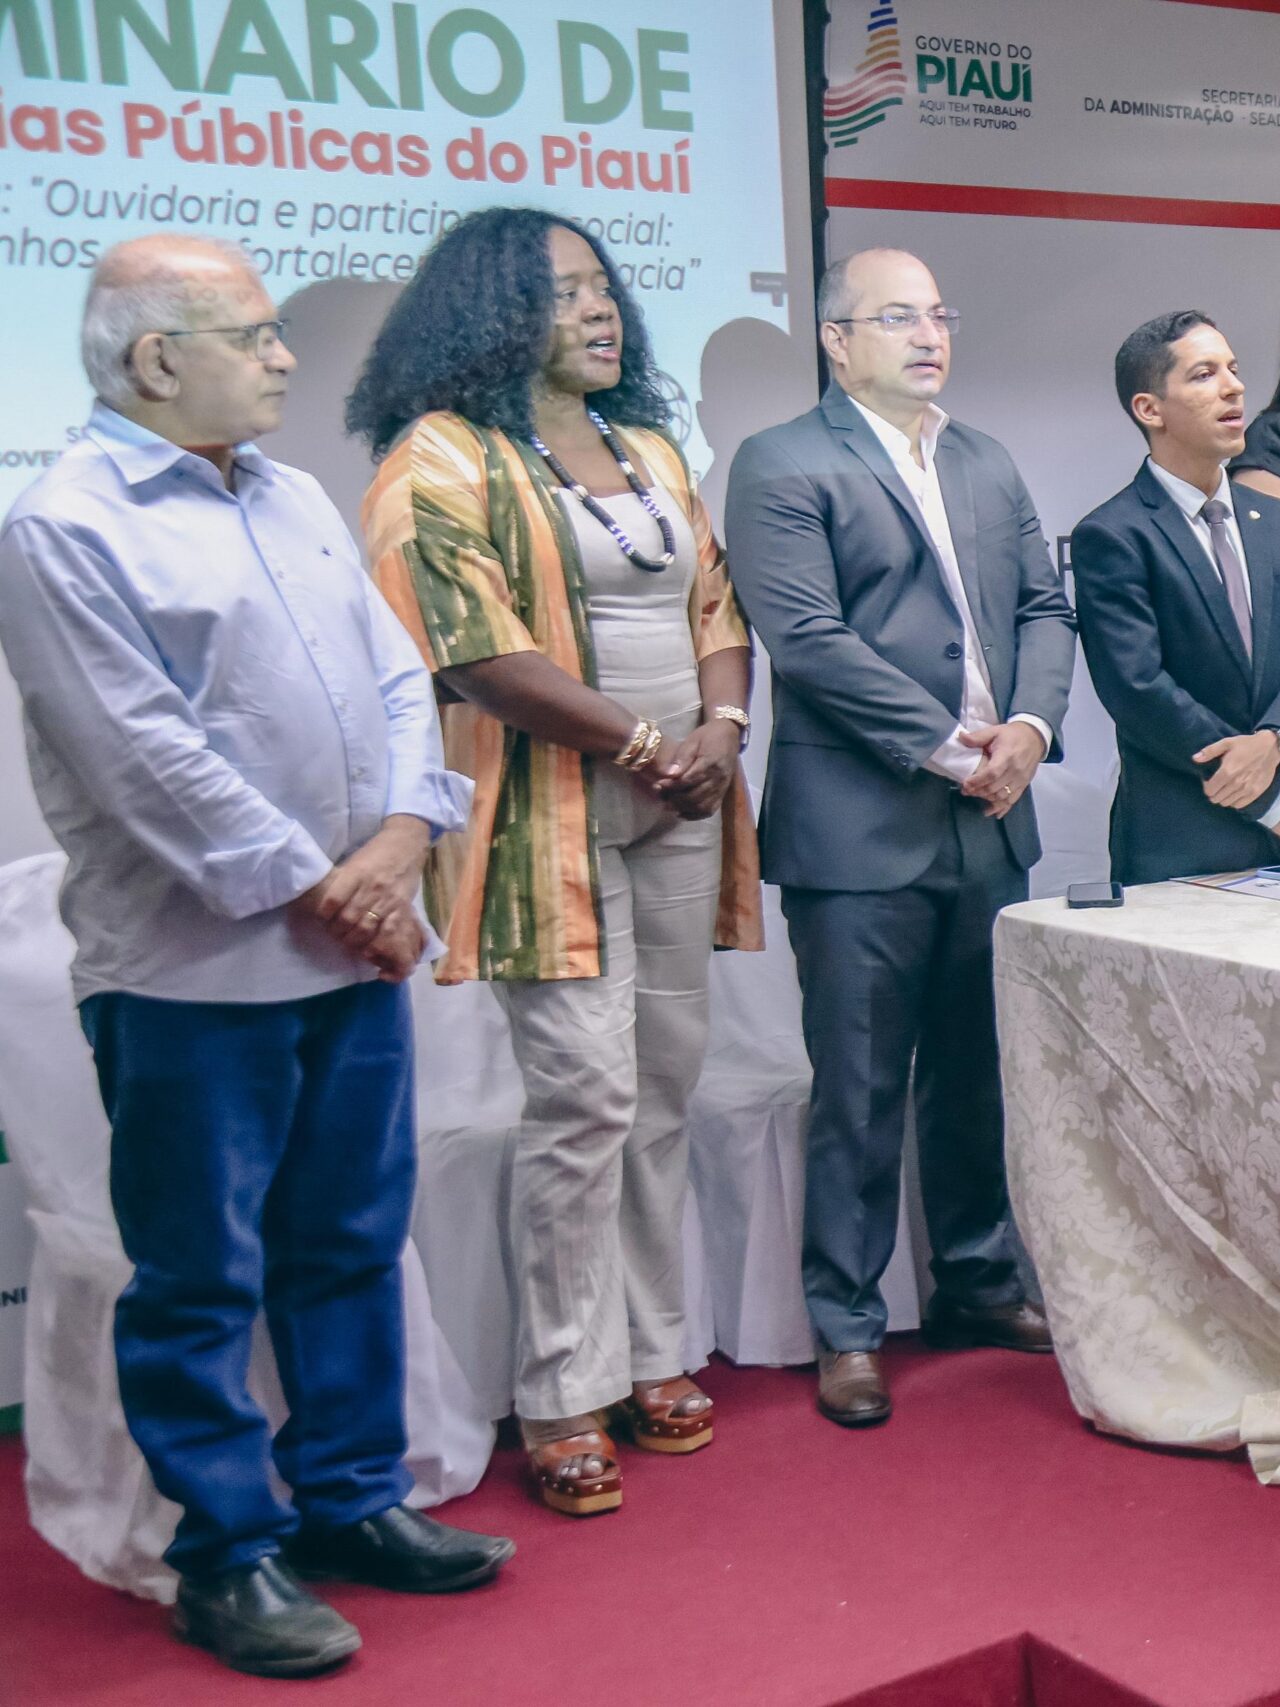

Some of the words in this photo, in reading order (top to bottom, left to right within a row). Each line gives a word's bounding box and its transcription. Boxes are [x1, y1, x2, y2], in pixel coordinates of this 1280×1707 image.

[915, 35, 1001, 57] GOVERNO
[1007, 43, 1032, 60] DO
[557, 19, 694, 133] DE
[916, 53, 1032, 102] PIAUÍ
[919, 100, 945, 112] AQUI
[948, 101, 970, 112] TEM
[972, 103, 1031, 118] TRABALHO
[919, 114, 946, 126] AQUI
[948, 116, 970, 127] TEM
[973, 118, 1017, 130] FUTURO
[1084, 97, 1106, 112] DA
[1110, 99, 1234, 125] ADMINISTRAÇÃO
[122, 99, 432, 178] Públicas
[445, 127, 528, 184] do
[541, 130, 691, 194] Piauí
[274, 200, 298, 229] e
[571, 211, 673, 247] ocial:
